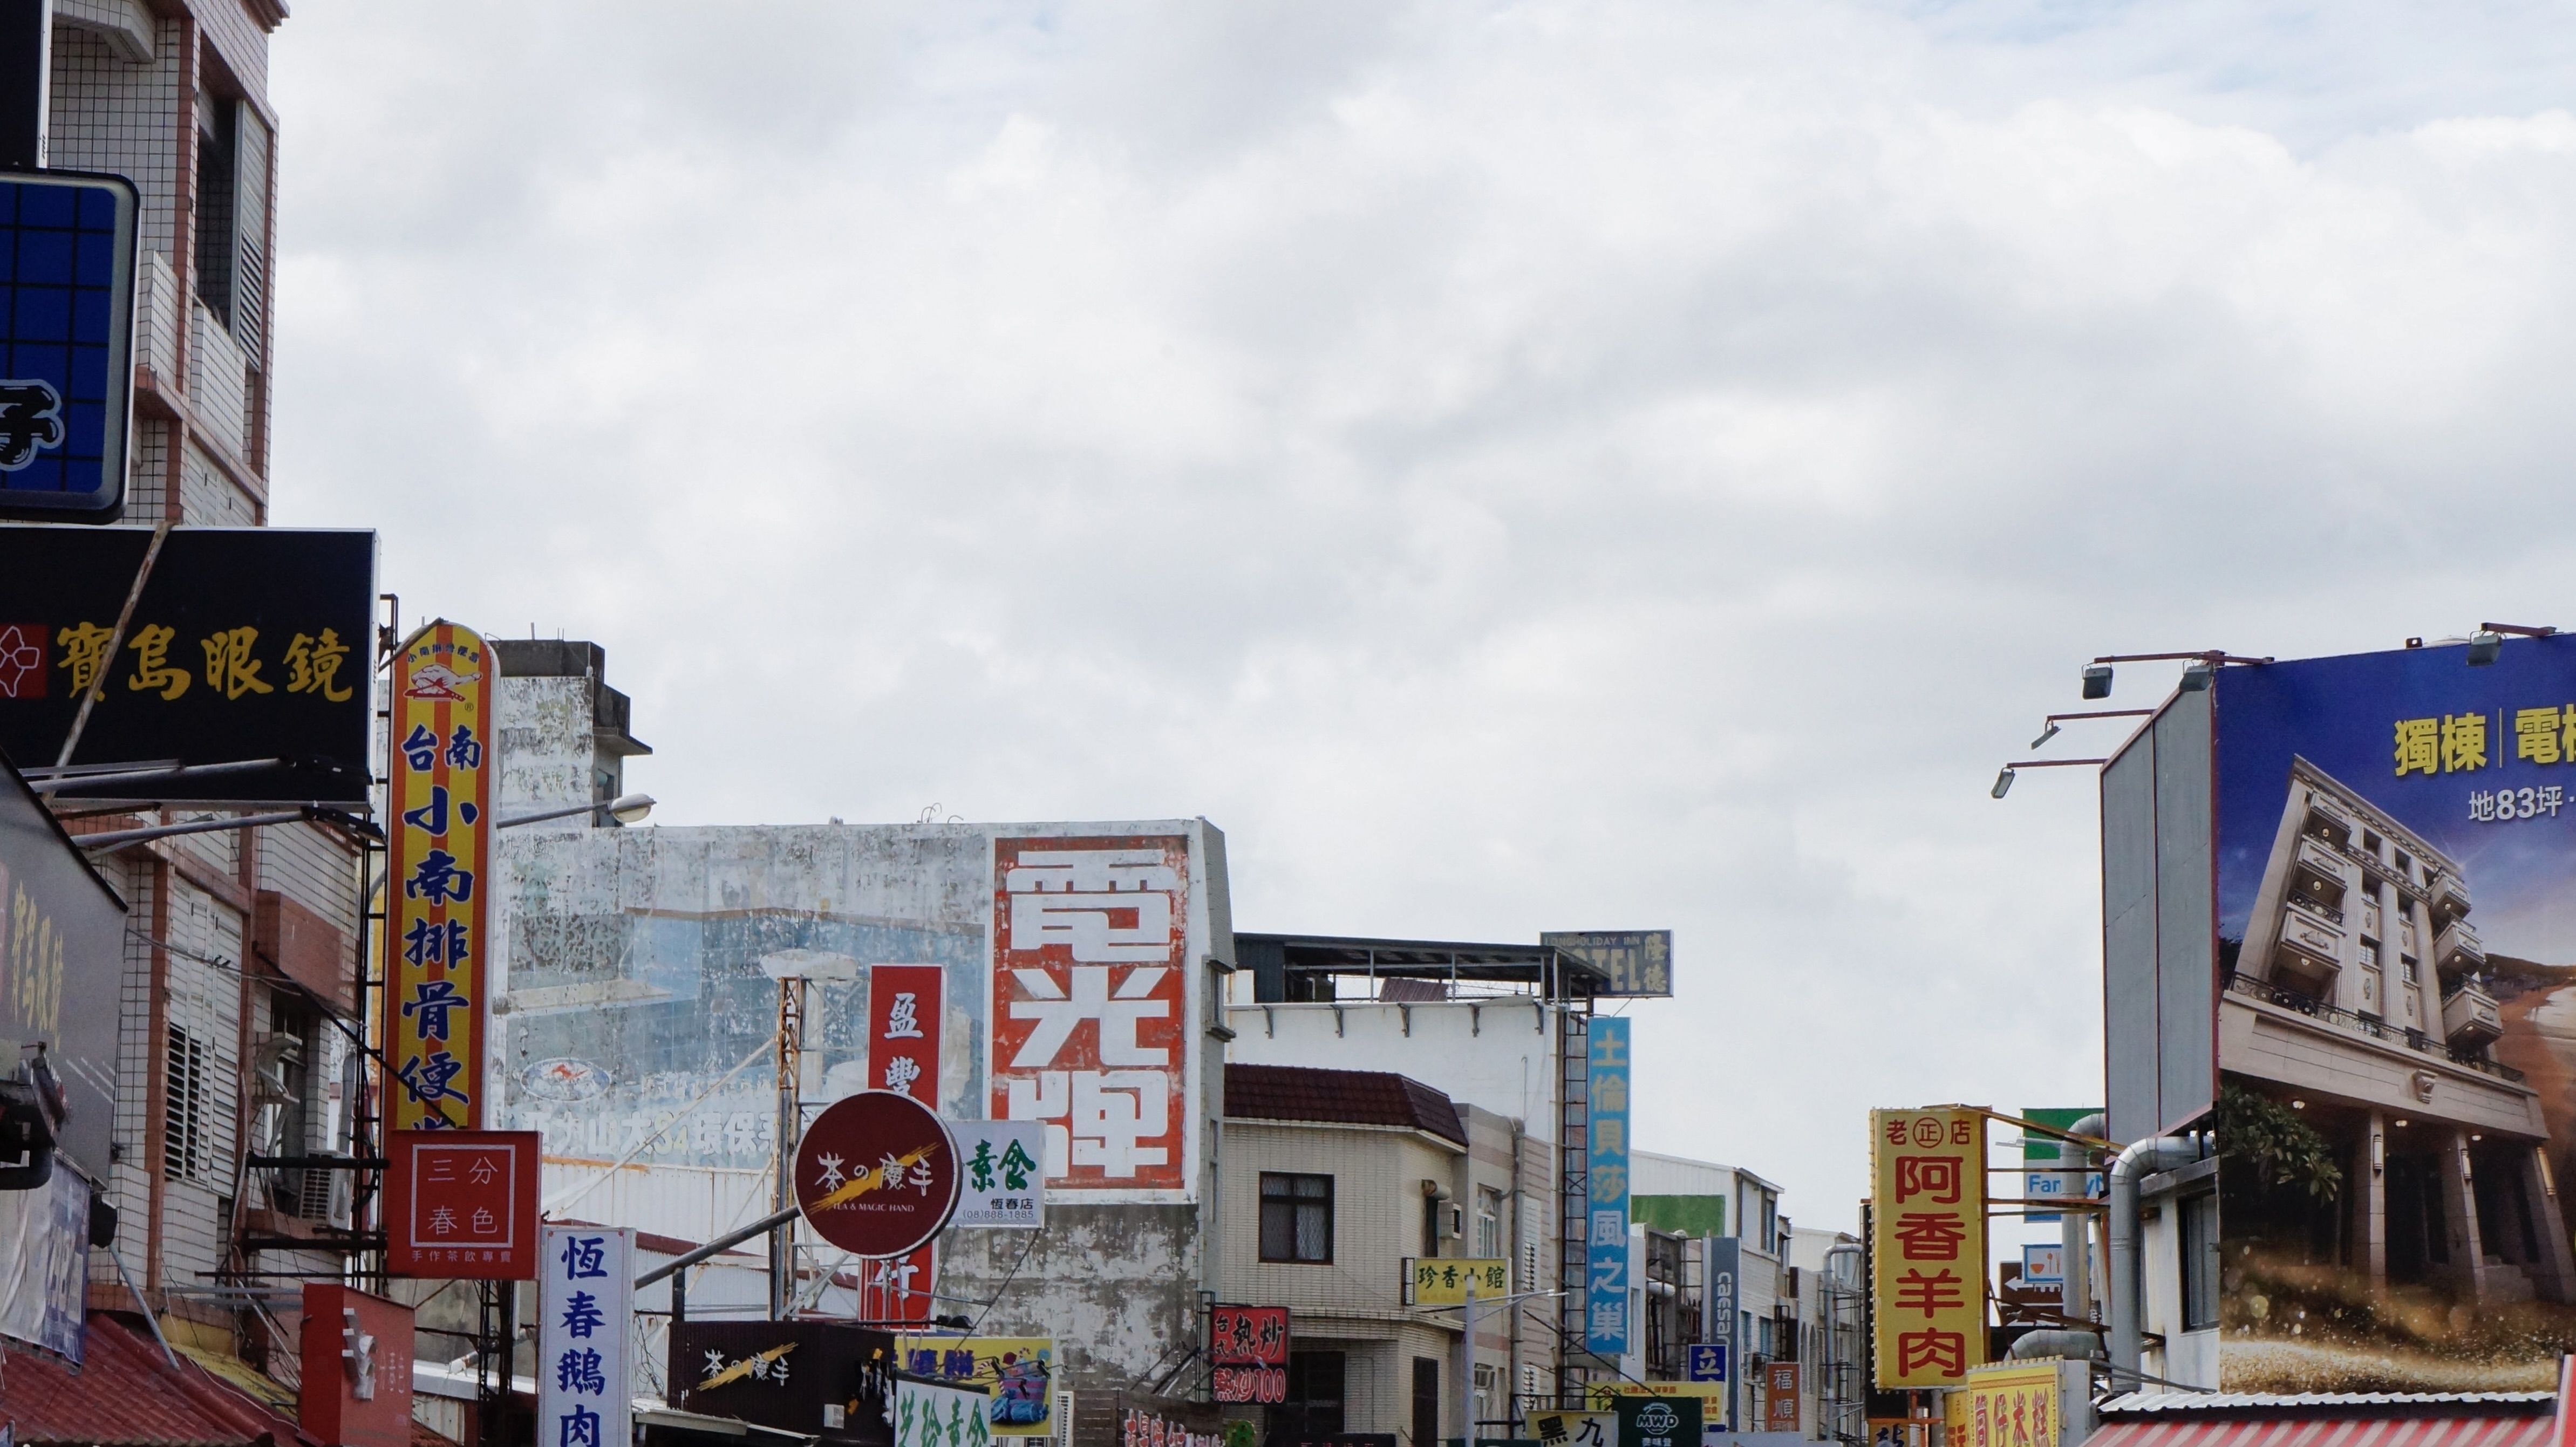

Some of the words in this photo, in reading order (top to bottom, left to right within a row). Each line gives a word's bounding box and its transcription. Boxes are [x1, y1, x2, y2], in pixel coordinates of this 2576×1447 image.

[57, 622, 353, 702] 寶島眼鏡
[401, 724, 482, 773] 台南
[2394, 712, 2487, 776] 獨棟
[398, 786, 479, 1129] 小南排骨便
[428, 1157, 498, 1185] 三分
[815, 1151, 933, 1197] 茶の魔手
[965, 1139, 1036, 1192] 素食
[428, 1205, 498, 1236] 春色
[858, 1203, 887, 1212] MAGIC
[889, 1204, 915, 1212] HAND
[991, 1198, 1034, 1209] 恆春店
[412, 1250, 511, 1263] 手作茶飲專賣
[1894, 1156, 1966, 1377] 阿香羊肉
[556, 1236, 608, 1447] 恆春鵝肉
[1695, 1347, 1721, 1381] 立
[1774, 1369, 1794, 1419] 福順
[1637, 1414, 1679, 1428] MWD
